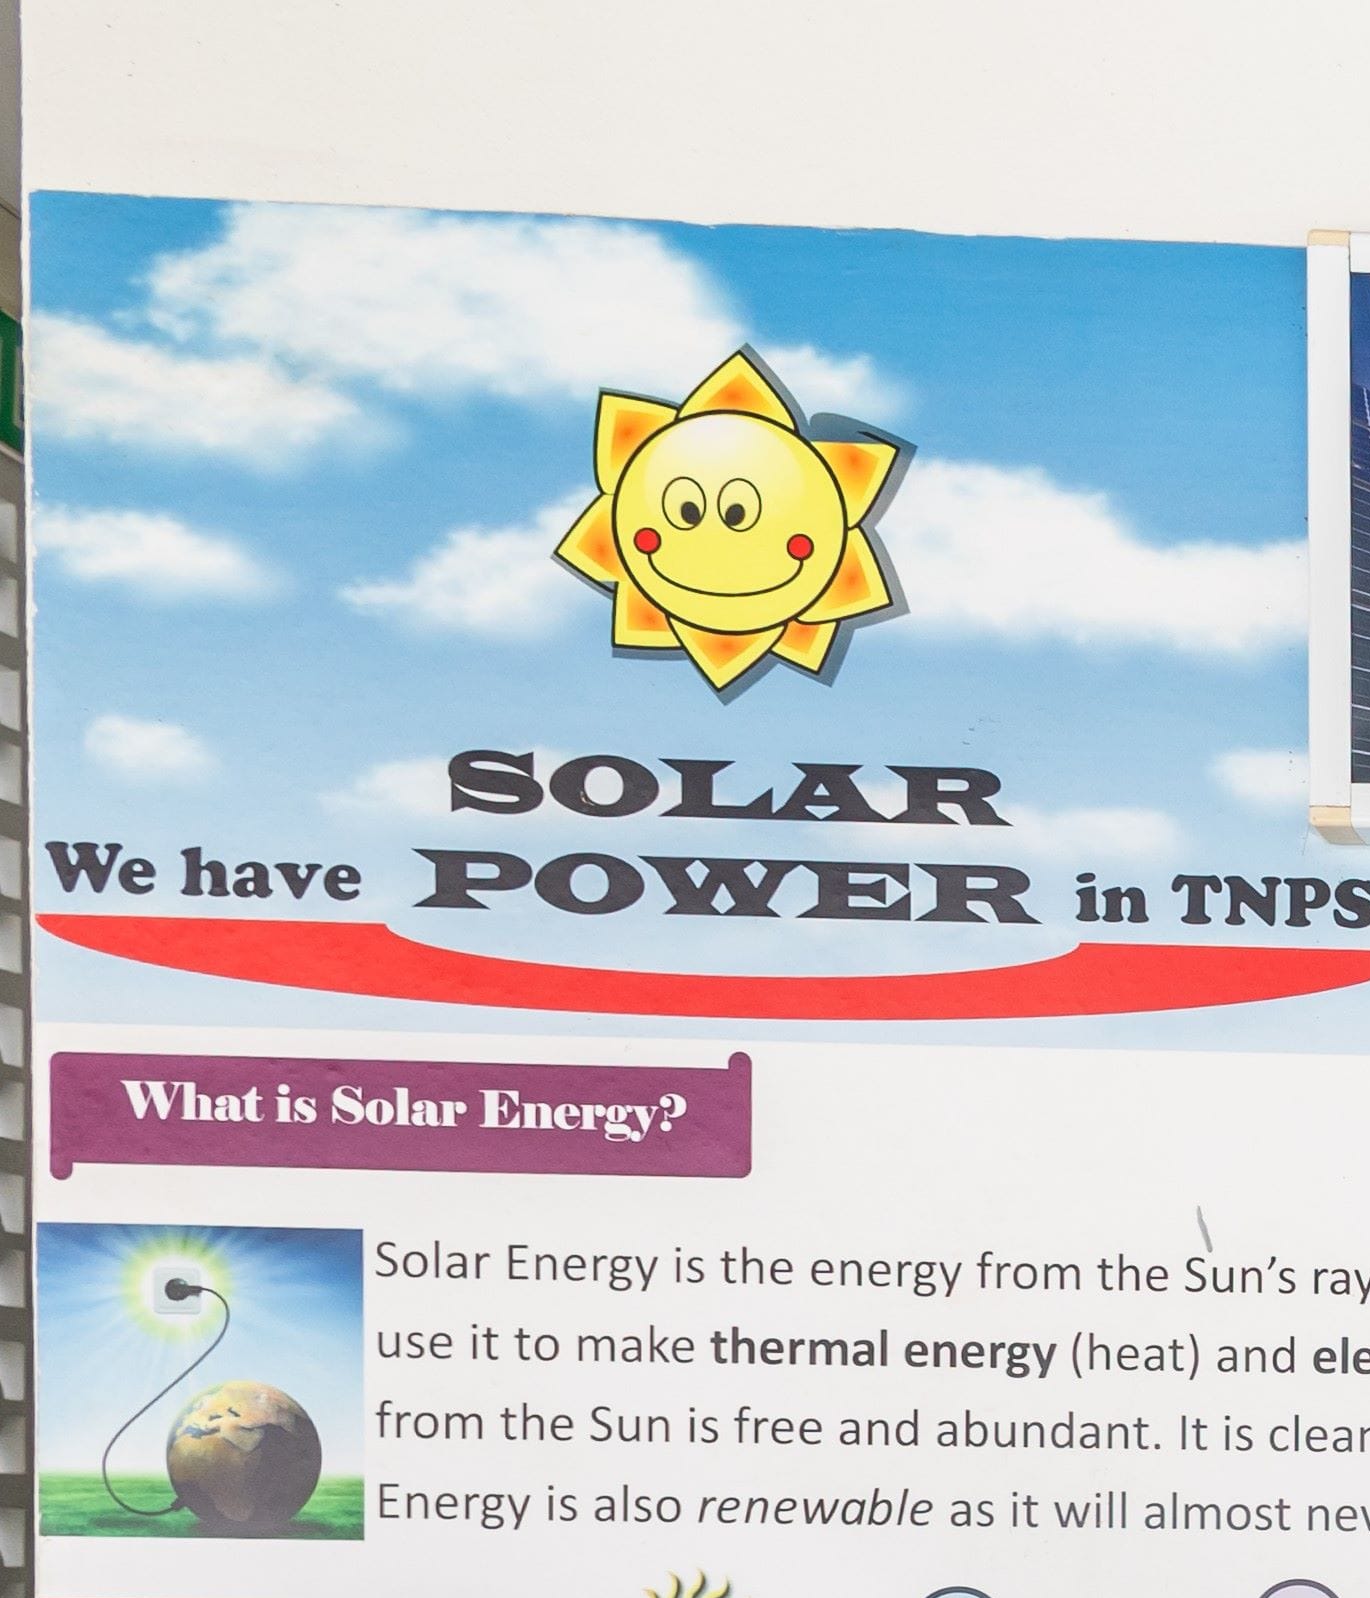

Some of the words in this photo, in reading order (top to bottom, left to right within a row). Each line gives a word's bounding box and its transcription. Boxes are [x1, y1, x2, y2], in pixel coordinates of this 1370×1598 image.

[448, 750, 1012, 826] SOLAR
[45, 841, 156, 894] We
[181, 847, 361, 900] have
[412, 849, 1042, 924] POWER
[1076, 873, 1149, 923] in
[121, 1080, 263, 1122] What
[276, 1084, 317, 1123] is
[332, 1086, 467, 1126] Solar
[479, 1090, 686, 1142] Energy?
[376, 1241, 490, 1279] Solar
[509, 1245, 658, 1291] Energy
[676, 1247, 704, 1283] is
[720, 1247, 793, 1284] the
[811, 1260, 962, 1297] energy
[977, 1251, 1080, 1290] from
[1097, 1254, 1168, 1291] the
